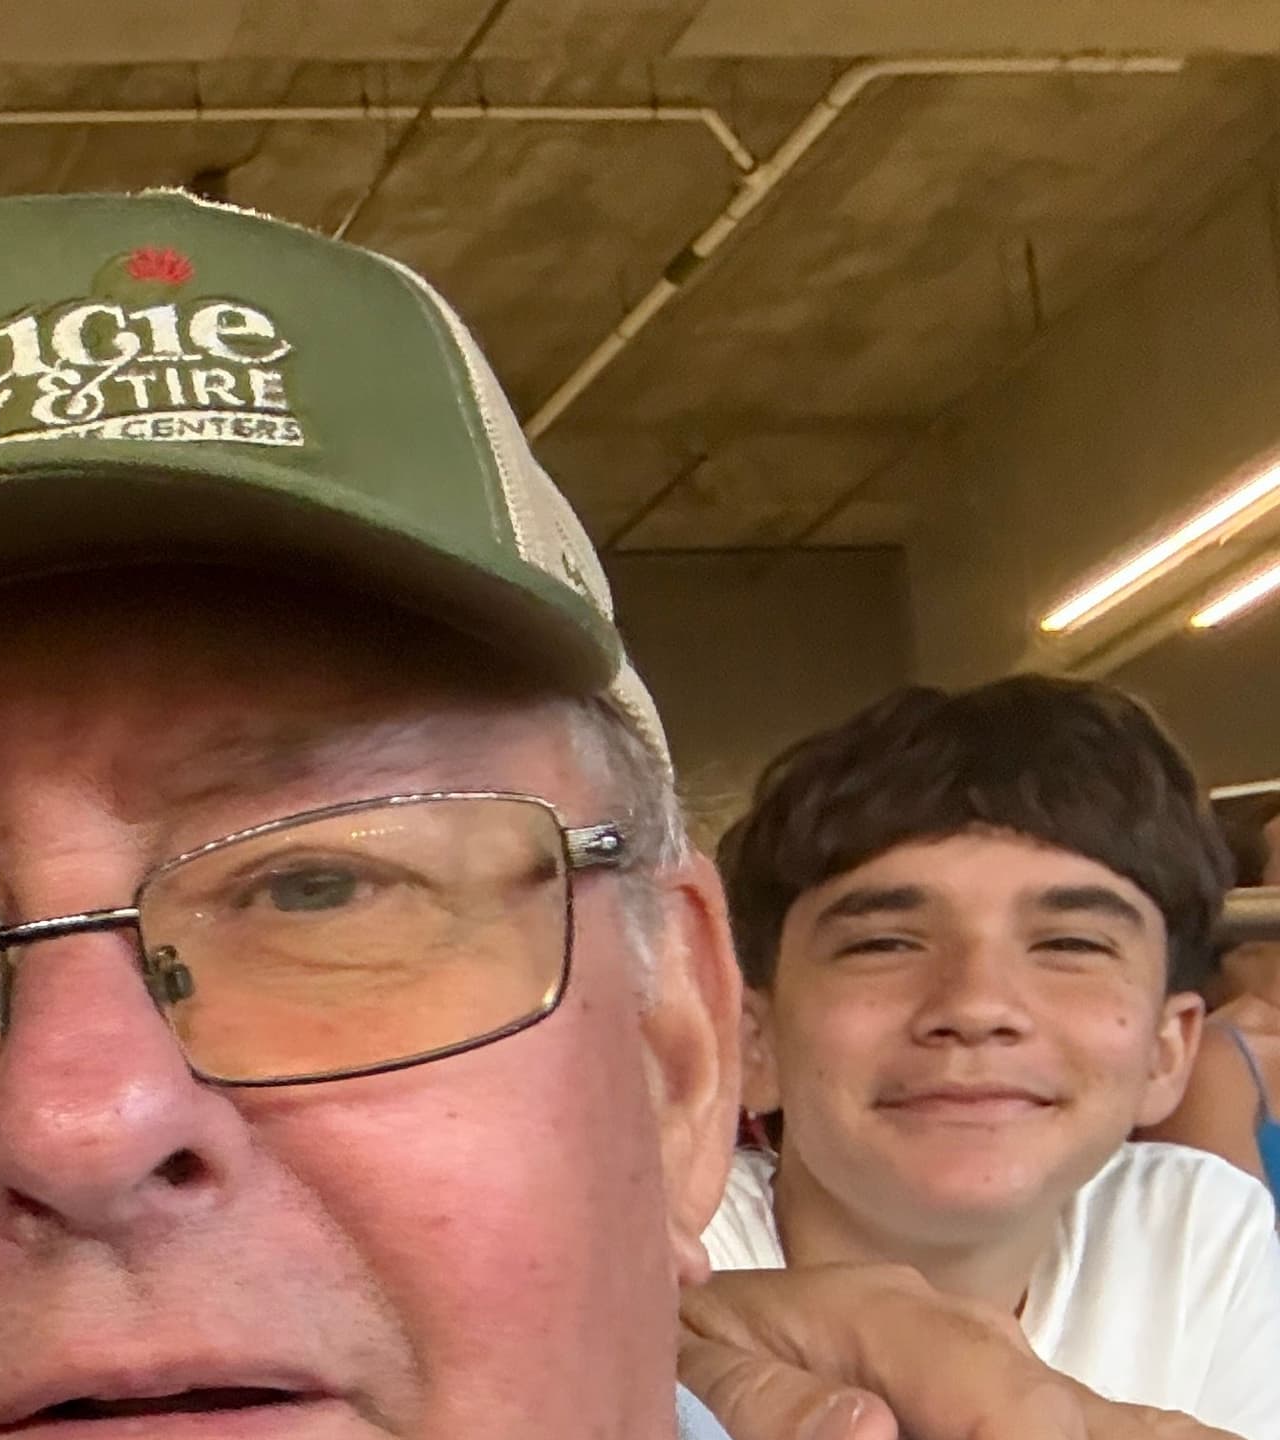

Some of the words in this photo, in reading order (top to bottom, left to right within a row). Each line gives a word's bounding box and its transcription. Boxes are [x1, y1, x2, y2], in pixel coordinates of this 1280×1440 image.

[32, 362, 122, 425] &
[118, 368, 288, 410] TIRE
[120, 416, 302, 441] CENTERS
